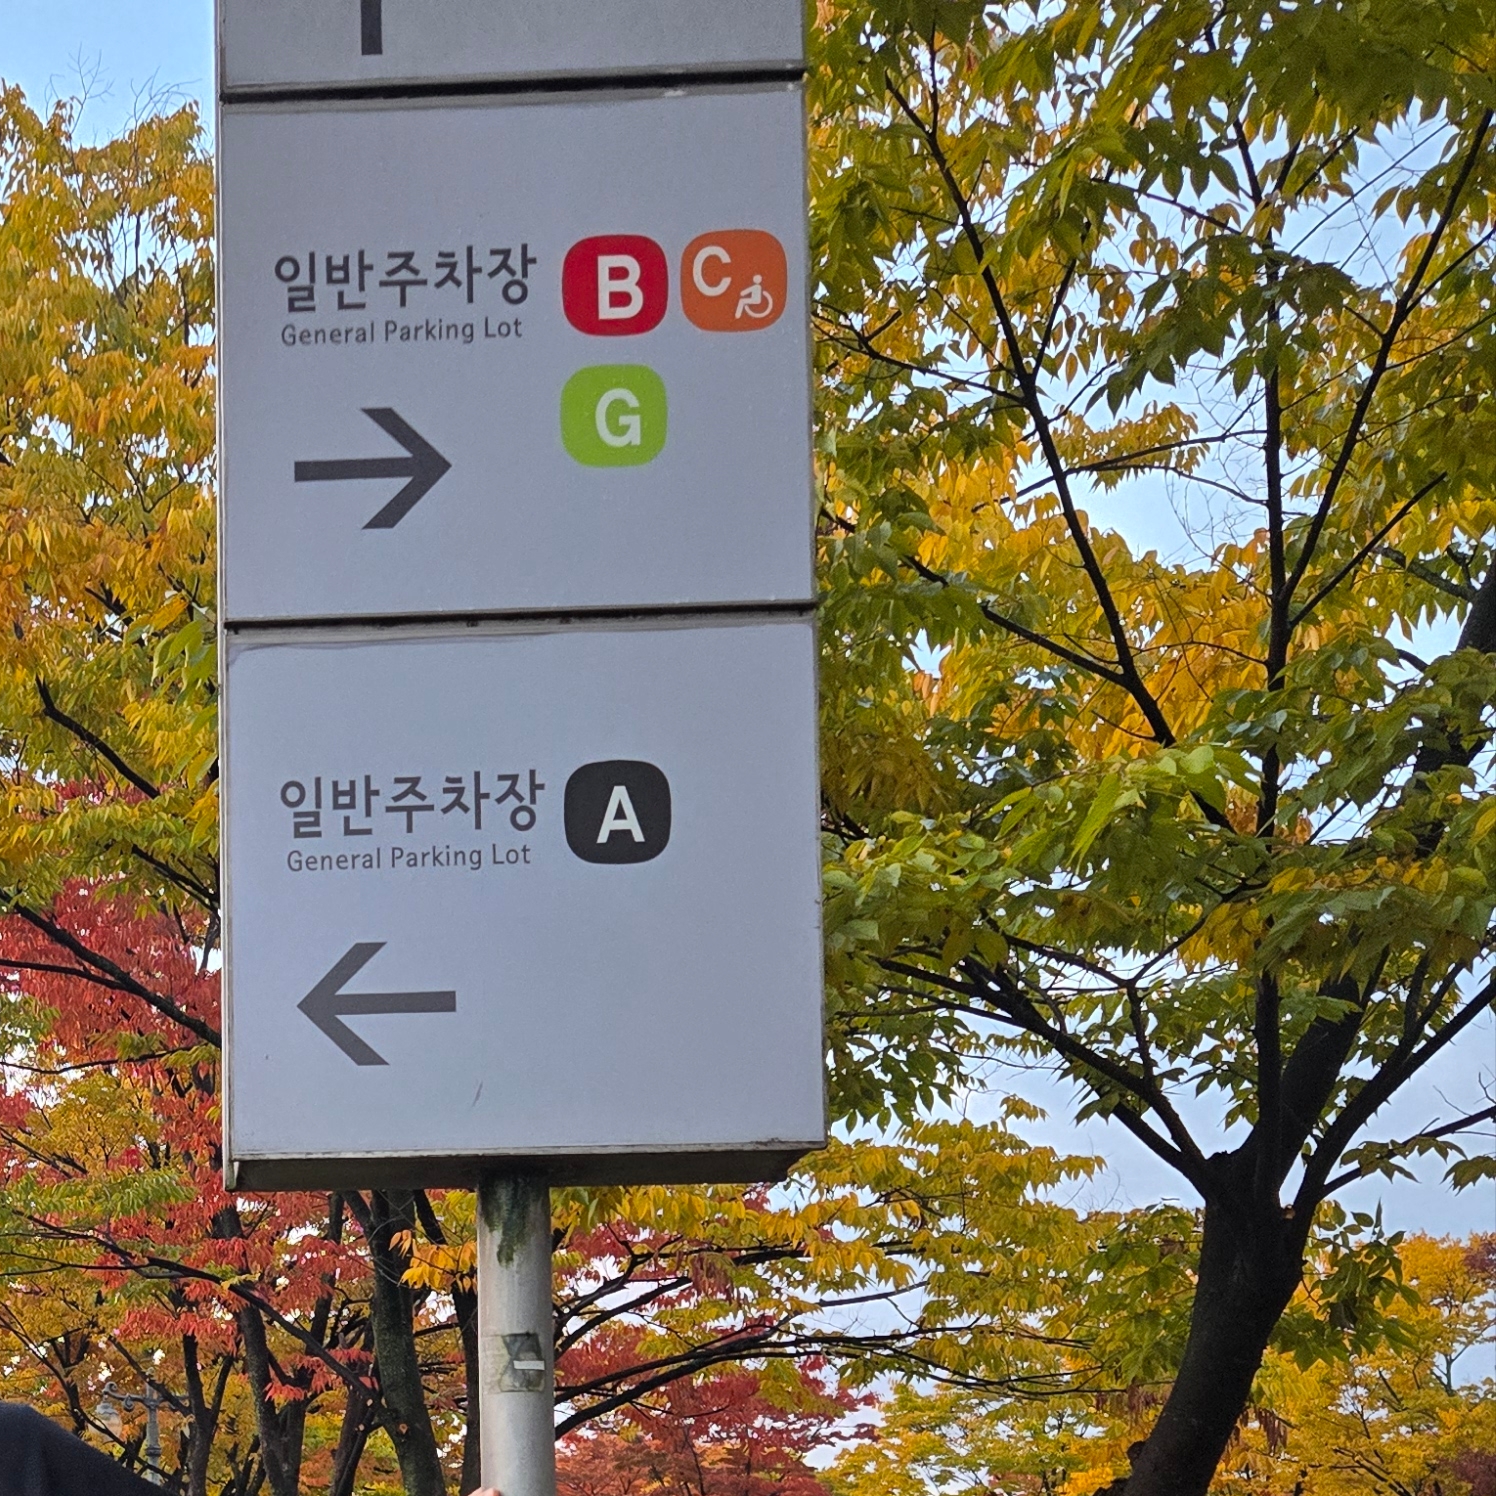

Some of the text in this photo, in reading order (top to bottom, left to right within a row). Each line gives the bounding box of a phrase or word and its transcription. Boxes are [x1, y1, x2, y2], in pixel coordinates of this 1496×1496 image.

[274, 243, 732, 321] 일반주차장 B C
[281, 316, 522, 347] General Parking Lot
[595, 387, 642, 447] G
[280, 768, 645, 844] 일반주차장 A
[286, 843, 531, 872] General Parking Lot
